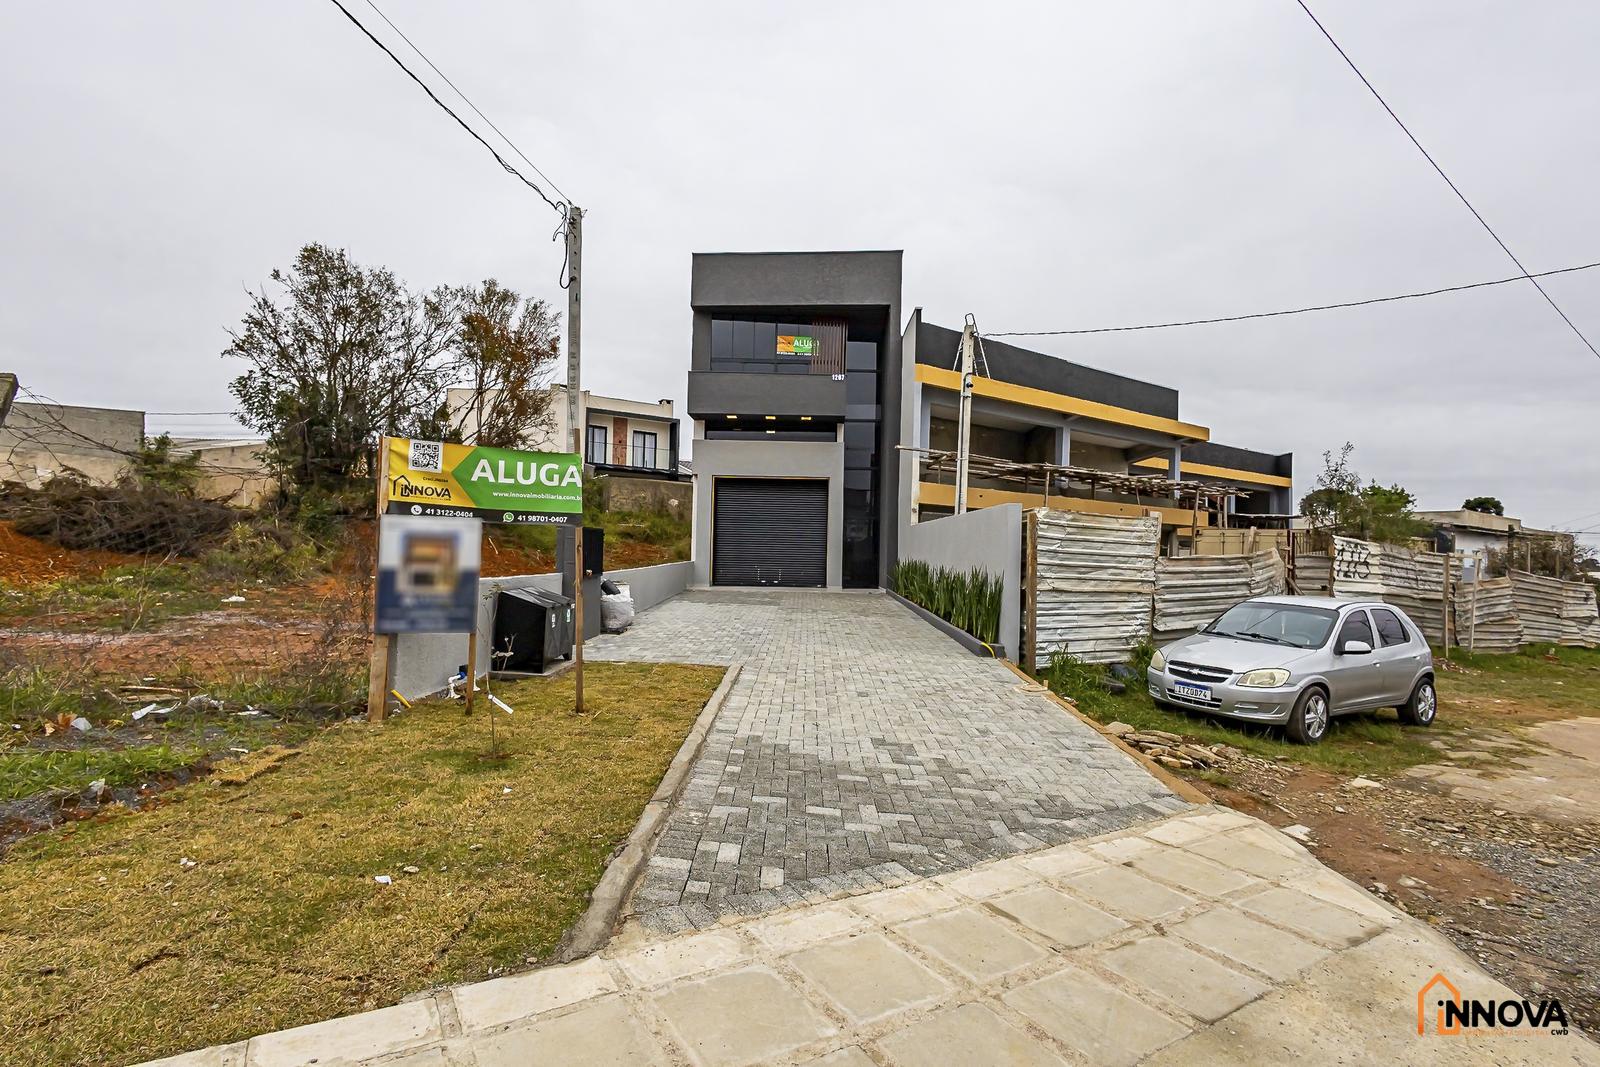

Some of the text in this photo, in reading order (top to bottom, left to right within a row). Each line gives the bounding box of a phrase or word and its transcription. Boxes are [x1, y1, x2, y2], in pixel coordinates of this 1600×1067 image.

[793, 339, 820, 349] ALU
[470, 458, 582, 488] ALUGA
[436, 509, 473, 518] 3122-0404
[527, 515, 568, 523] 98701-0407
